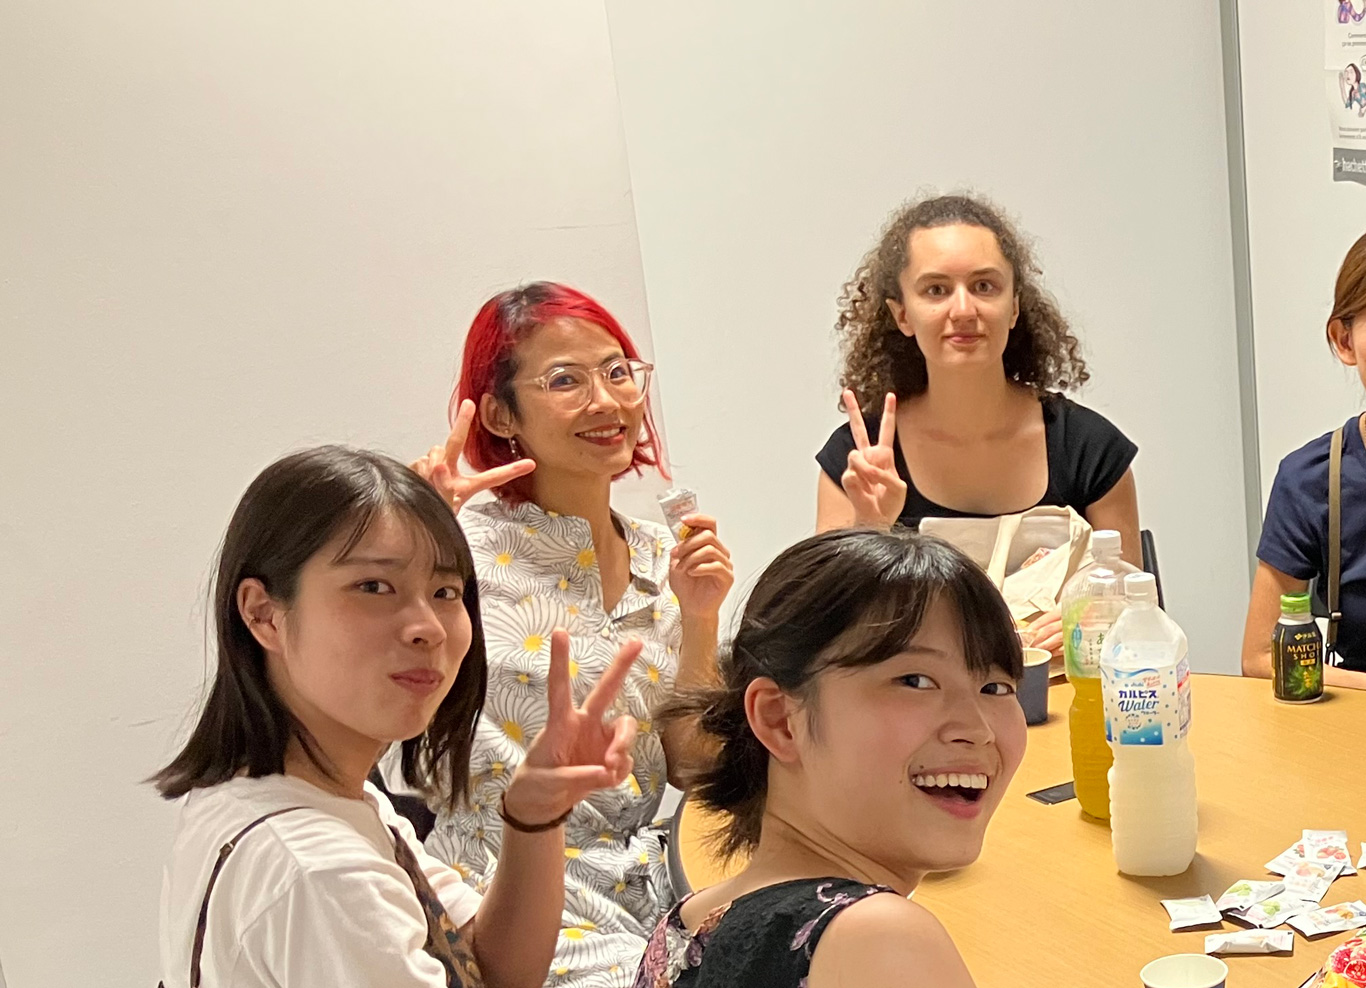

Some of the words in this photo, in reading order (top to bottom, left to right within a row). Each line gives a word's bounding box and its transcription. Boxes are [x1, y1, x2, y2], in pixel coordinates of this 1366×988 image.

[1119, 690, 1157, 698] カルピス
[1118, 700, 1159, 712] Water
